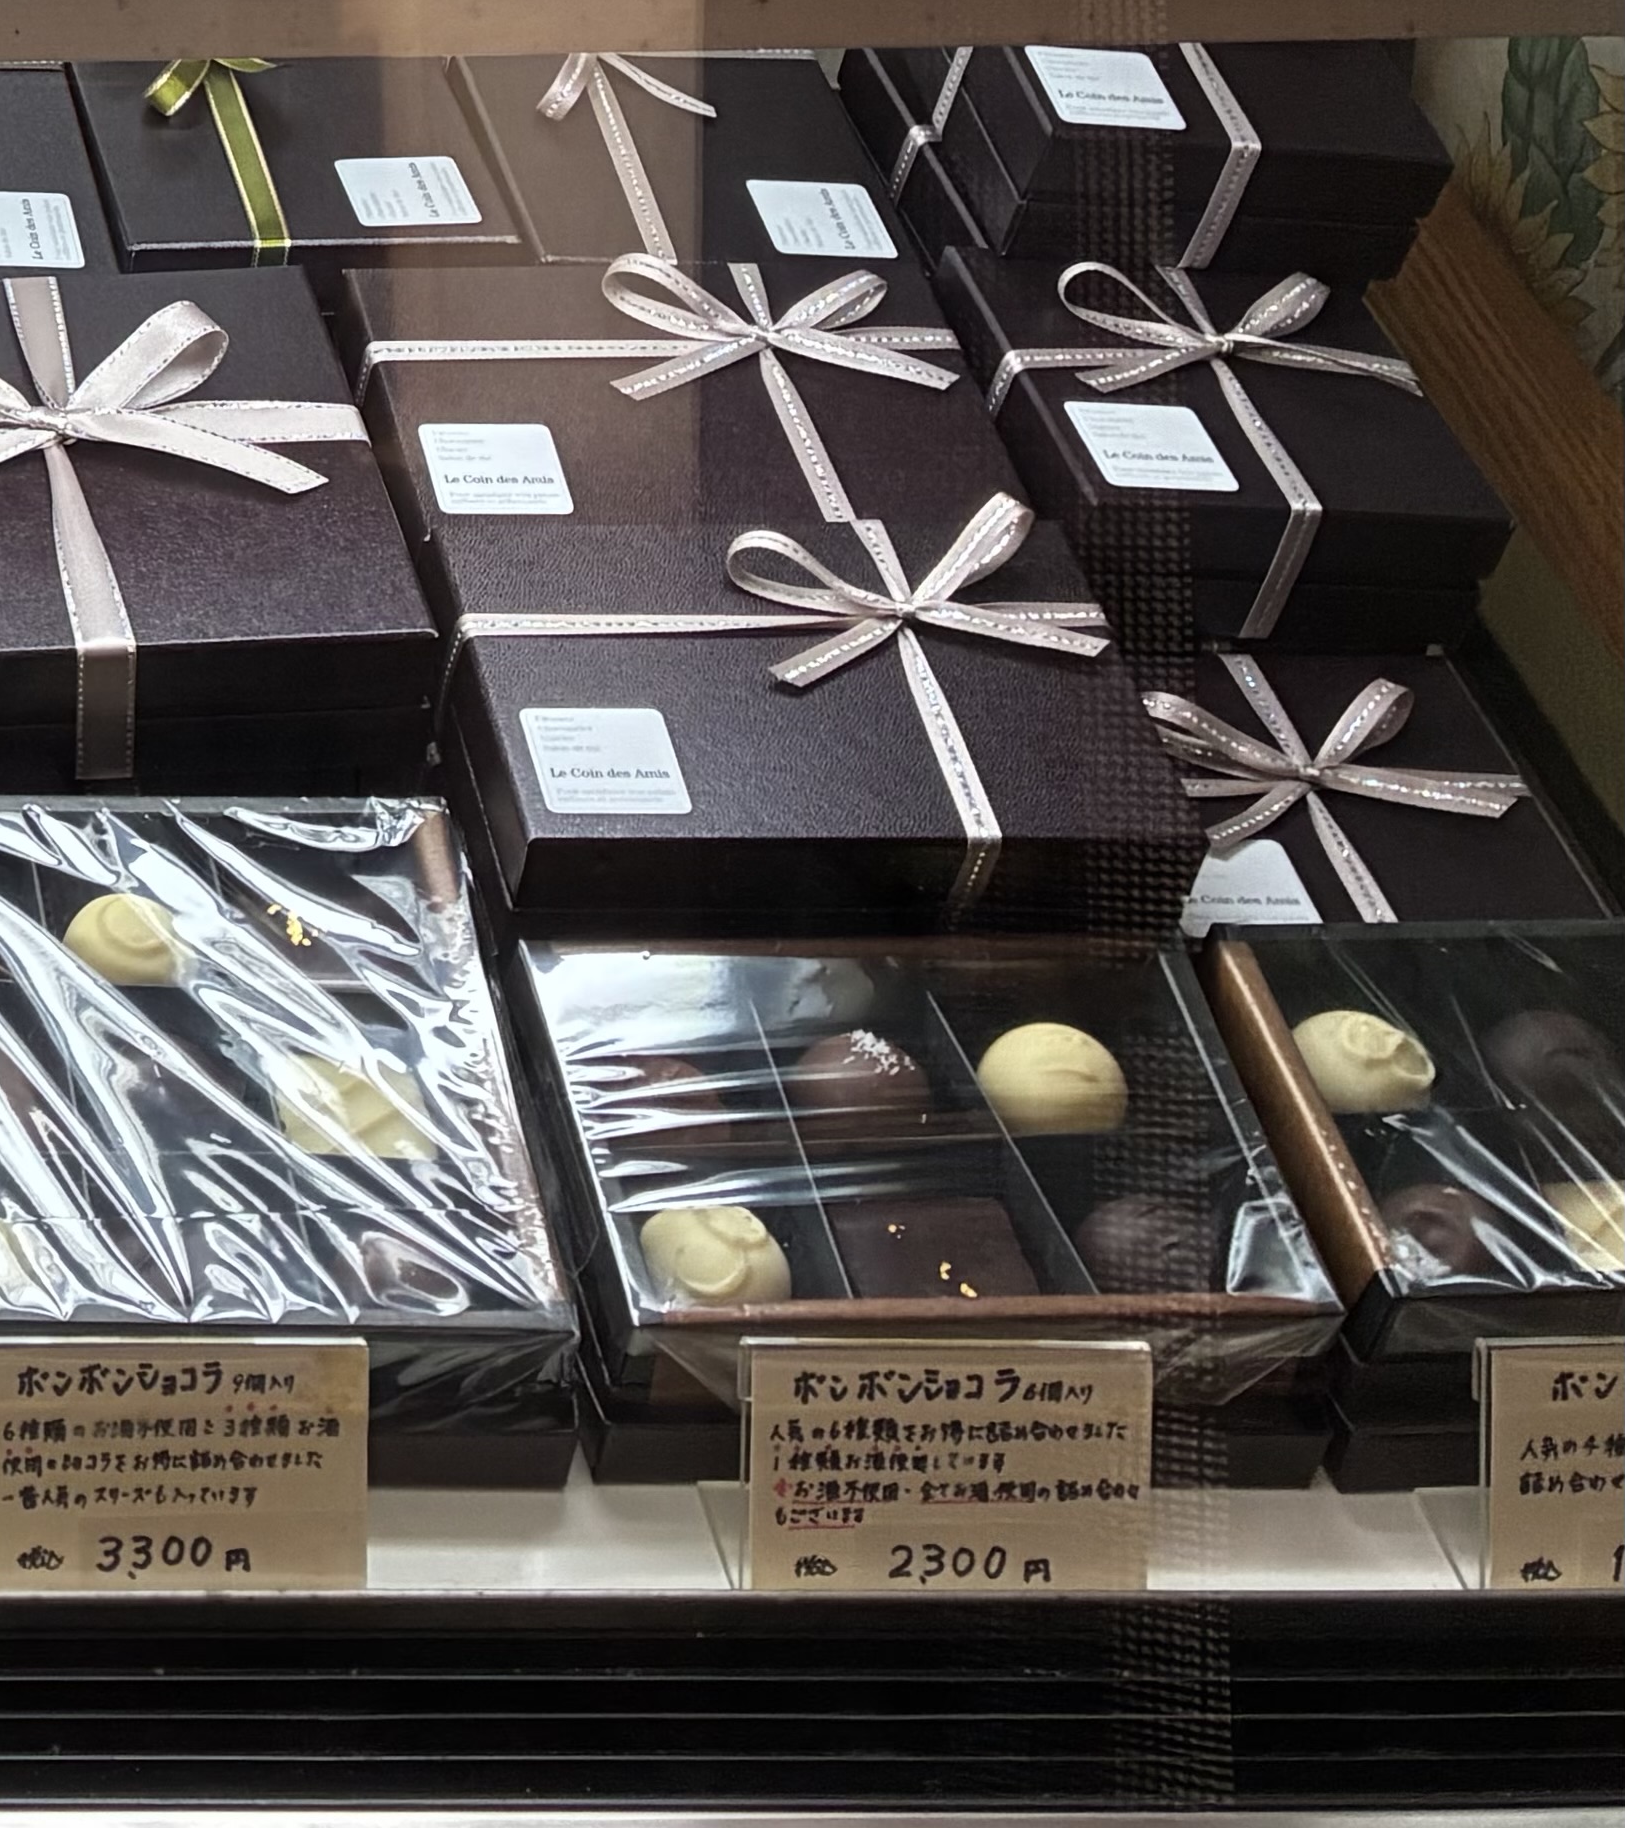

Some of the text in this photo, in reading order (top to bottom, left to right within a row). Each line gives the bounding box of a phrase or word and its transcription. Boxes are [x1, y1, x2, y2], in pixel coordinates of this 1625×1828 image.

[550, 768, 670, 778] Le Coin des Amis
